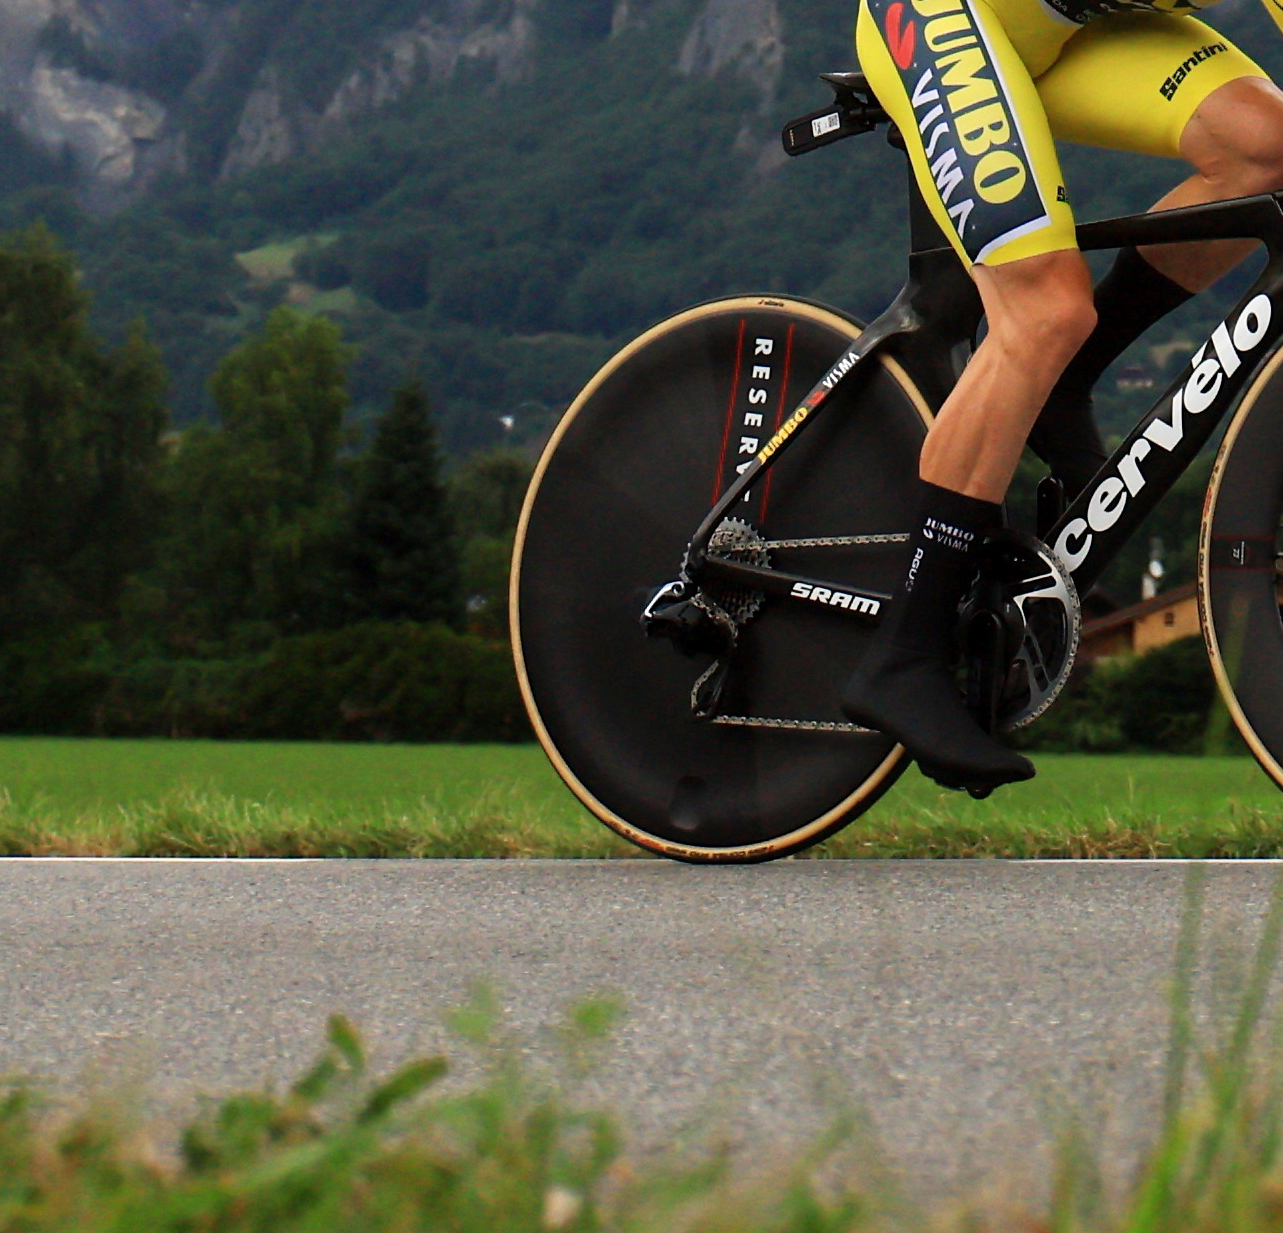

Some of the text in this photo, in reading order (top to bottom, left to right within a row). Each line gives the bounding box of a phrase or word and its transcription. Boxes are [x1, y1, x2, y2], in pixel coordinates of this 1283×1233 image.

[1159, 42, 1228, 101] Santini
[911, 68, 975, 240] VISMA
[758, 352, 860, 464] JUMBO VISMA
[1054, 293, 1272, 573] cervélo
[925, 517, 974, 541] JUMBO
[937, 533, 969, 553] VISMA
[790, 583, 880, 616] SRAM
